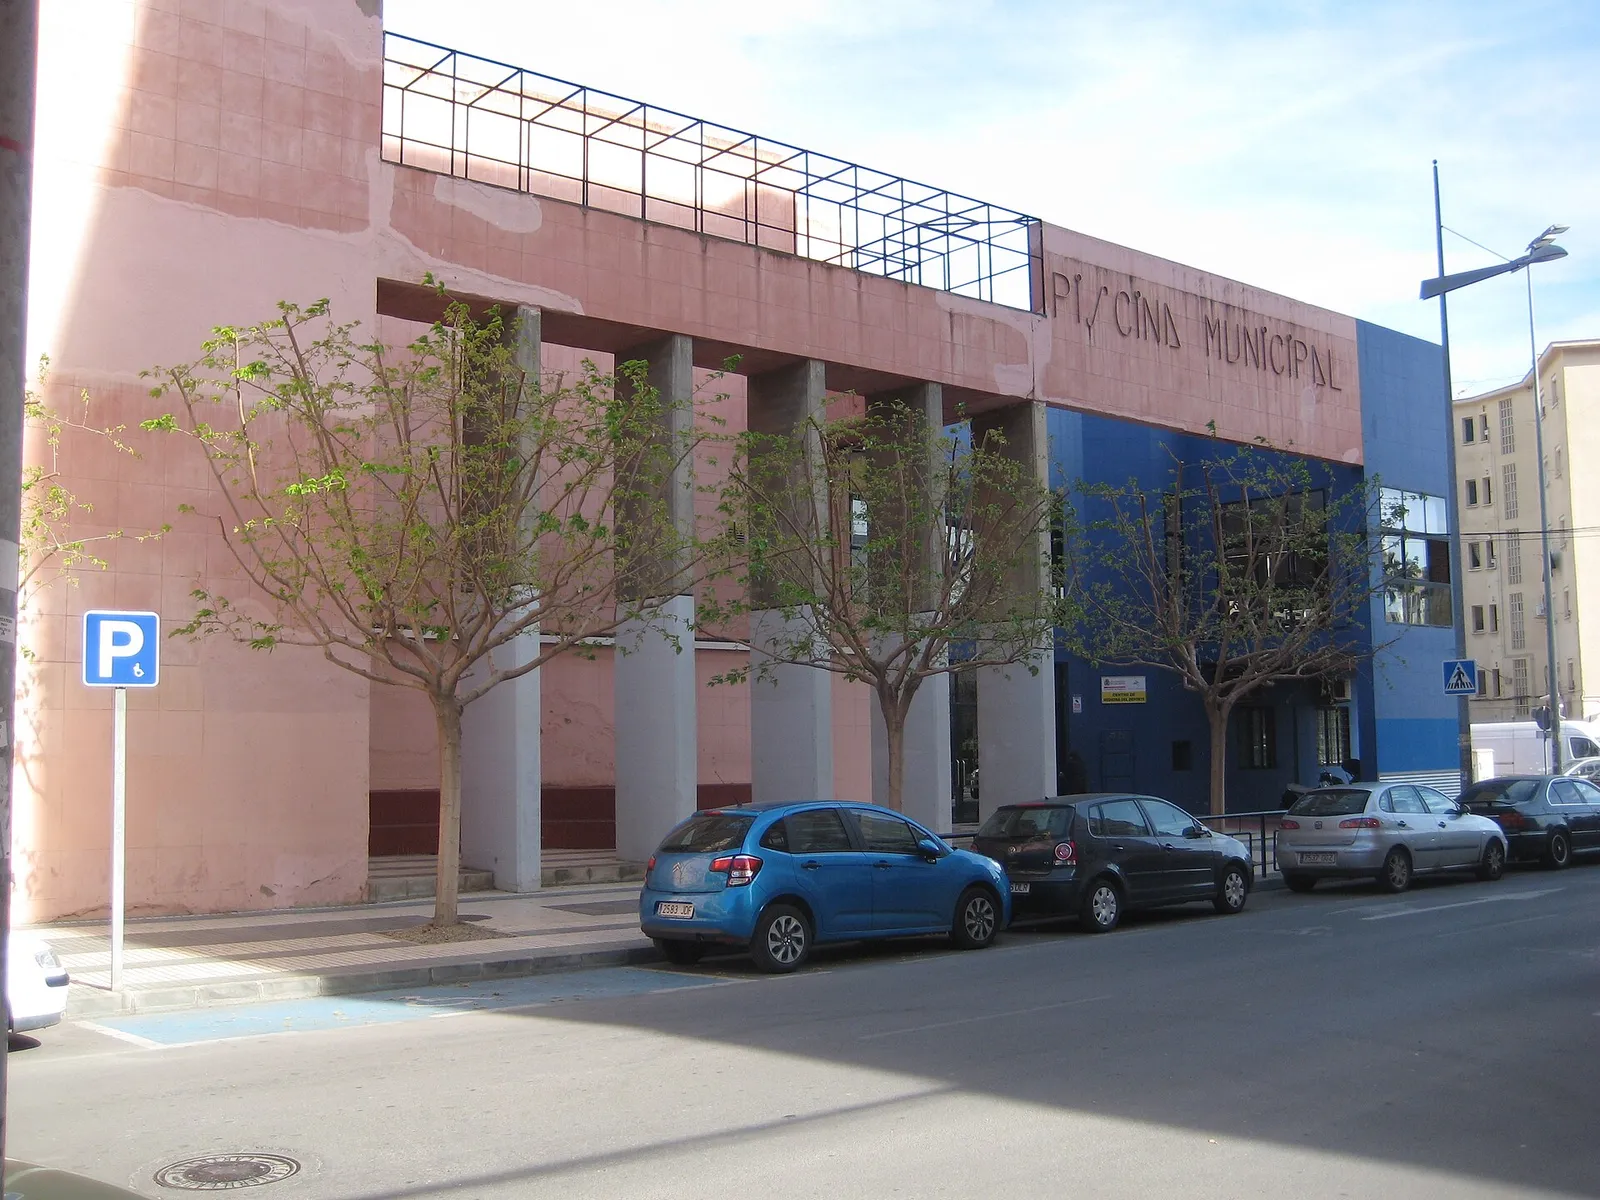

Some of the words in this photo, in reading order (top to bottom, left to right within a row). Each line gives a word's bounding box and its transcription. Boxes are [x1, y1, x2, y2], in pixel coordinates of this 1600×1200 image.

[1051, 271, 1182, 349] PISCINA
[1203, 313, 1343, 392] MUNICIPAL
[98, 619, 145, 678] P
